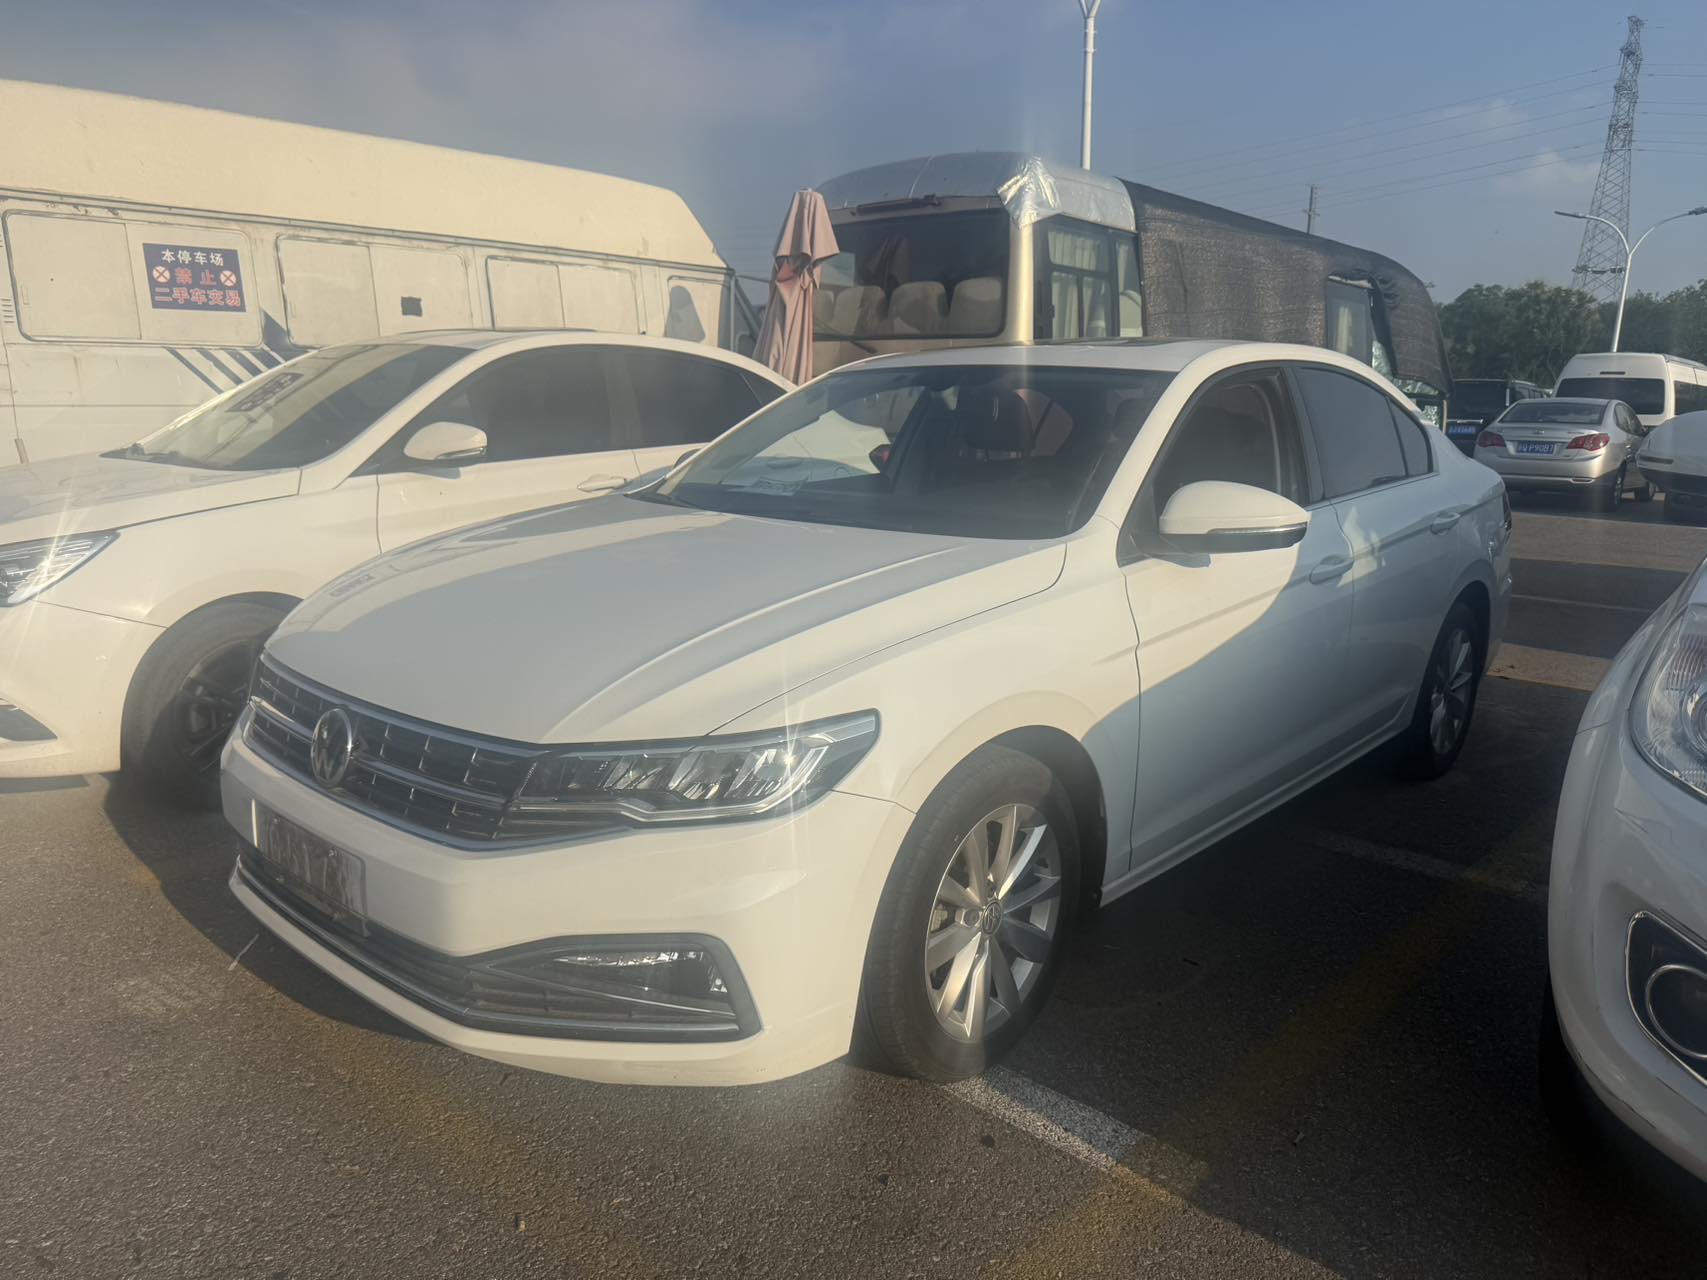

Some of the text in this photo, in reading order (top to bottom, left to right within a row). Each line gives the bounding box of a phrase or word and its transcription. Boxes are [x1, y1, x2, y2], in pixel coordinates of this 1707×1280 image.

[161, 248, 224, 266] 本停车场
[154, 287, 241, 307] 二手车交易
